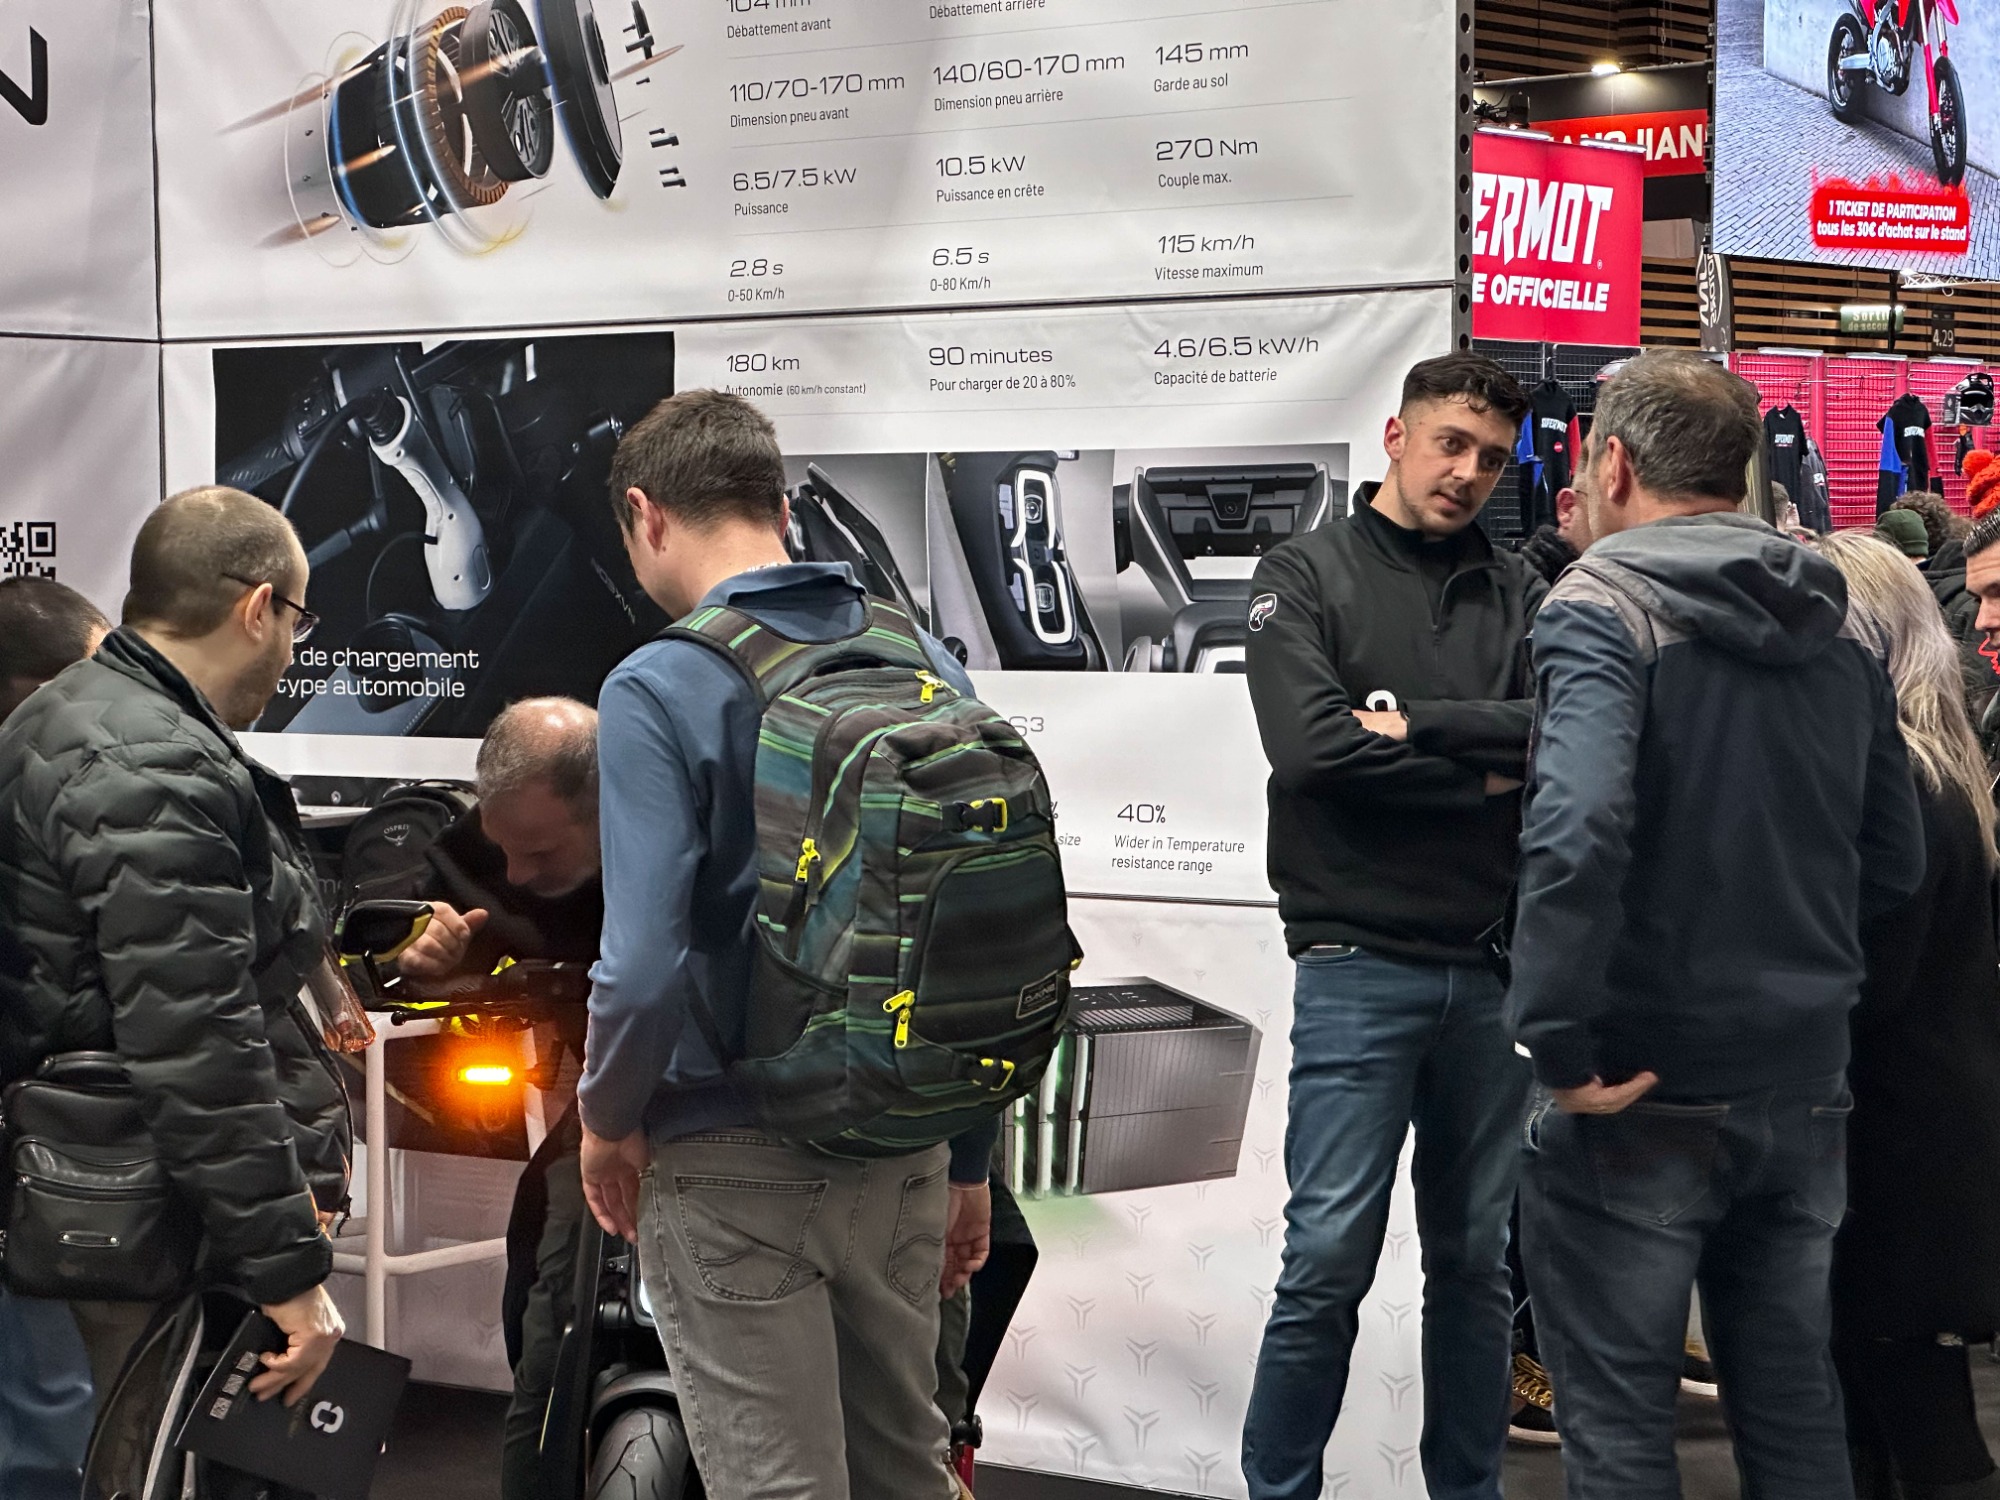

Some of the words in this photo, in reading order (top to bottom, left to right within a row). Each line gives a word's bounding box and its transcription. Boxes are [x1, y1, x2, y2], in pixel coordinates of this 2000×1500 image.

[800, 17, 832, 32] avant
[1155, 42, 1203, 66] 145
[1209, 44, 1249, 61] mm
[932, 53, 1080, 86] 140/60-170
[1085, 56, 1125, 72] mm
[729, 73, 863, 102] 110/70-170
[868, 76, 905, 91] mm
[1153, 77, 1190, 93] Garde
[1192, 77, 1208, 90] au
[1210, 72, 1228, 88] sol
[933, 95, 993, 112] Dimension
[994, 94, 1023, 110] pneu
[1025, 88, 1064, 104] arrière
[730, 111, 788, 128] Dimension
[789, 111, 818, 126] pneu
[819, 107, 849, 120] avant
[1155, 137, 1213, 162] 270
[1219, 139, 1258, 157] Nm
[935, 155, 986, 177] 10.5
[991, 155, 1026, 174] kW
[733, 167, 819, 192] 6.5/7.5
[823, 167, 857, 185] kW
[1158, 173, 1200, 190] Couple
[1202, 172, 1232, 185] max.
[936, 188, 994, 203] Puissance
[997, 187, 1011, 199] en
[1013, 183, 1045, 198] crête
[734, 202, 789, 216] Puissance
[1829, 199, 1835, 216] 1
[1835, 200, 1871, 218] TICKET
[1870, 201, 1886, 218] DE
[1885, 203, 1957, 222] PARTICIPATION
[1817, 220, 1840, 236] tous
[1840, 219, 1856, 236] les
[1856, 221, 1877, 237] 30€
[1914, 226, 1931, 239] sur
[1930, 223, 1940, 239] le
[1940, 224, 1967, 241] stand
[1158, 233, 1196, 254] 115
[1200, 234, 1255, 252] km/h
[932, 246, 973, 267] 6.5
[977, 252, 990, 264] s
[729, 258, 768, 278] 2.8
[772, 263, 784, 276] s
[1154, 266, 1200, 281] Vitesse
[1202, 263, 1264, 279] maximum
[727, 288, 753, 303] 0-50
[755, 286, 785, 301] Km/h
[929, 278, 957, 292] 0-80
[959, 276, 991, 291] Km/h
[1490, 273, 1611, 312] OFFICIELLE
[1153, 336, 1253, 359] 4.6/6.5
[1258, 336, 1319, 355] kW/h
[1932, 328, 1954, 347] 4.29
[726, 353, 767, 373] 180
[772, 356, 800, 371] km
[928, 346, 965, 366] 90
[970, 348, 1053, 365] minutes
[929, 378, 957, 392] Pour
[958, 377, 1004, 393] charger
[1005, 376, 1020, 390] de
[1022, 375, 1038, 389] 20
[1040, 375, 1048, 389] à
[1050, 374, 1076, 389] 80%
[1154, 370, 1208, 388] Capacité
[1210, 369, 1226, 384] de
[1228, 367, 1278, 383] batterie
[786, 384, 801, 396] (60
[801, 384, 823, 396] km/h
[823, 382, 867, 395] constant)
[300, 647, 328, 667] de
[332, 647, 480, 673] chargement
[332, 677, 466, 698] automobile
[1116, 803, 1166, 824] 40%
[1114, 834, 1150, 849] Wider
[1152, 835, 1164, 850] in
[1166, 836, 1245, 854] Temperature
[1111, 855, 1175, 871] resistance
[1177, 860, 1213, 875] range
